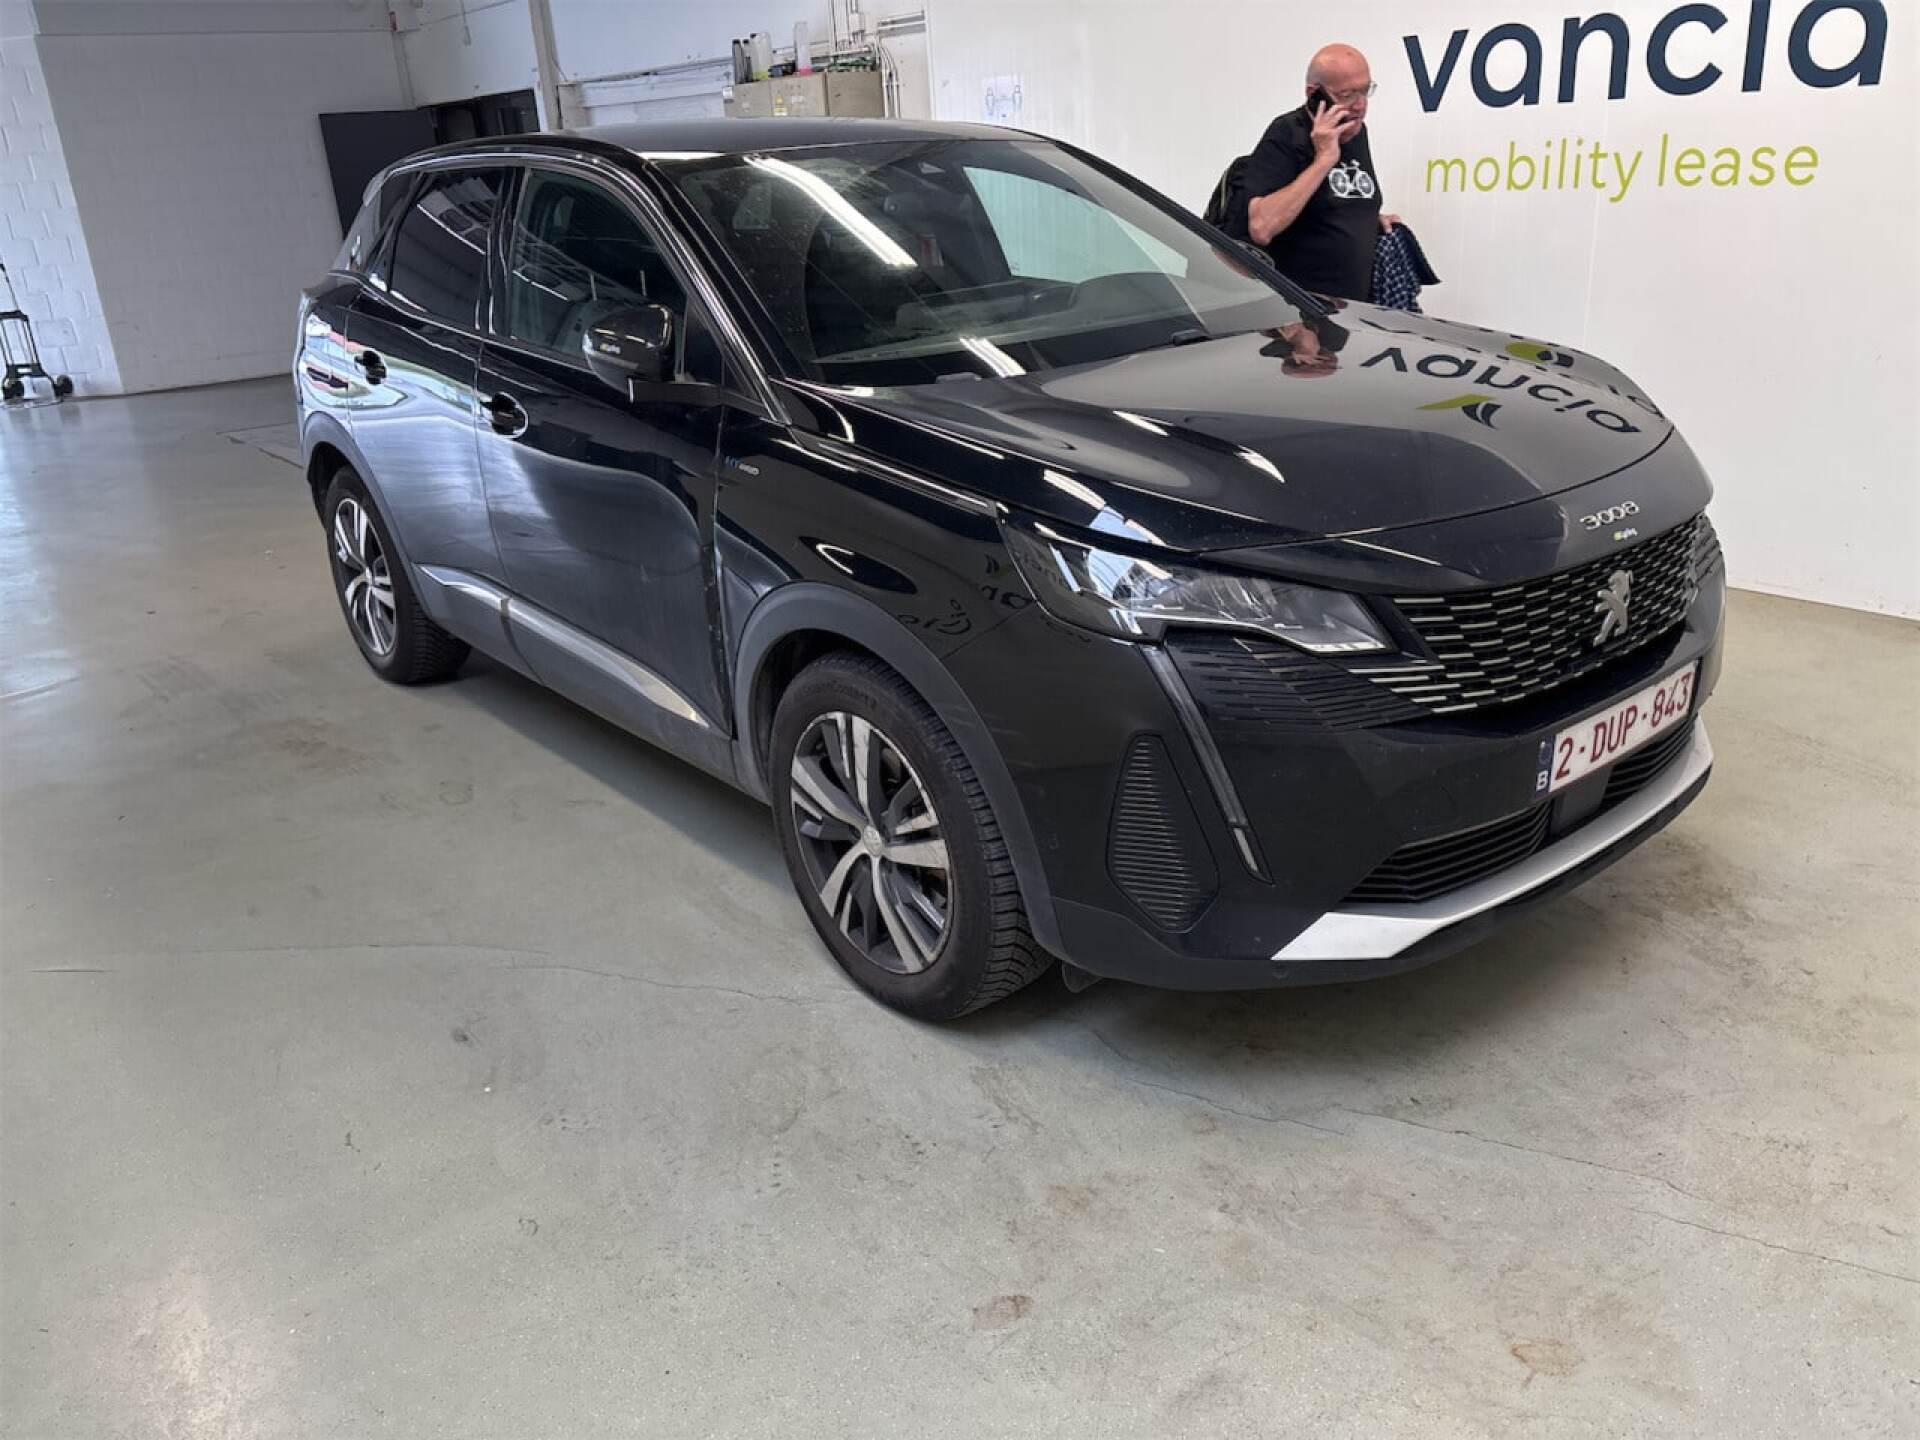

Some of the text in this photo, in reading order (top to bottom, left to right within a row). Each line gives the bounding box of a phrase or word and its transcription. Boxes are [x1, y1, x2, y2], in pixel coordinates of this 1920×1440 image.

[1427, 134, 1819, 203] mobility lease
[1580, 501, 1638, 530] 3008
[1536, 770, 1549, 791] B
